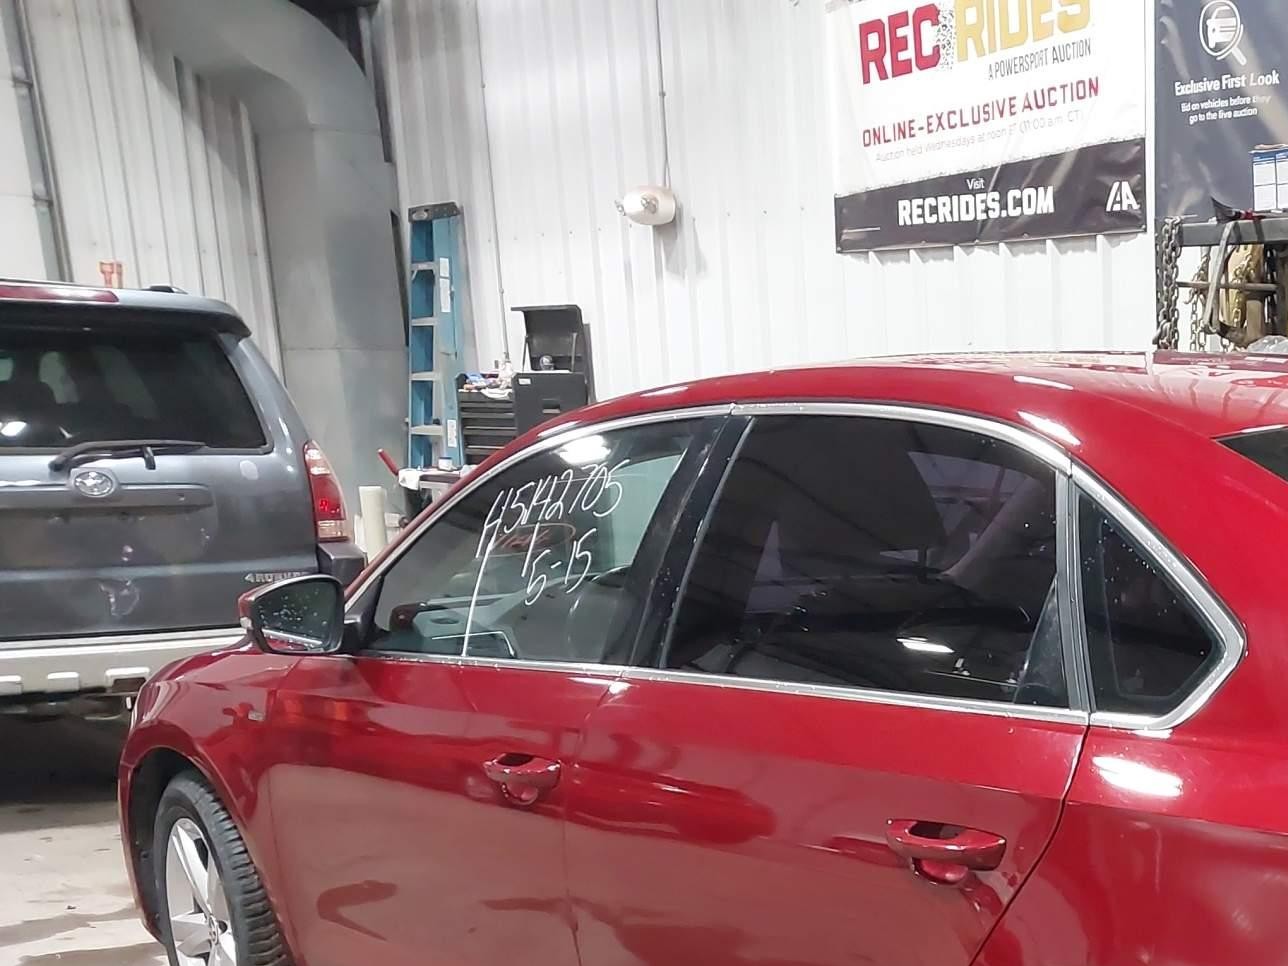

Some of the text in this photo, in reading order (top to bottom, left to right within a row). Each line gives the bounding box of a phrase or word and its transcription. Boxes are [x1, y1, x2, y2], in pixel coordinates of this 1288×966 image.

[859, 3, 940, 84] REC
[995, 48, 1049, 79] POWERSPORT
[1052, 38, 1091, 64] AUCTION
[1175, 70, 1280, 96] Exclusive First Look
[862, 76, 1099, 147] ONLINE-EXCLUSIVE AUCTION
[1189, 114, 1198, 125] go
[1198, 113, 1205, 121] to
[1206, 111, 1217, 120] the
[1200, 98, 1228, 109] vehicles
[1229, 96, 1251, 106] before
[966, 178, 985, 190] Visit
[898, 185, 1054, 226] RECRIDES.COM
